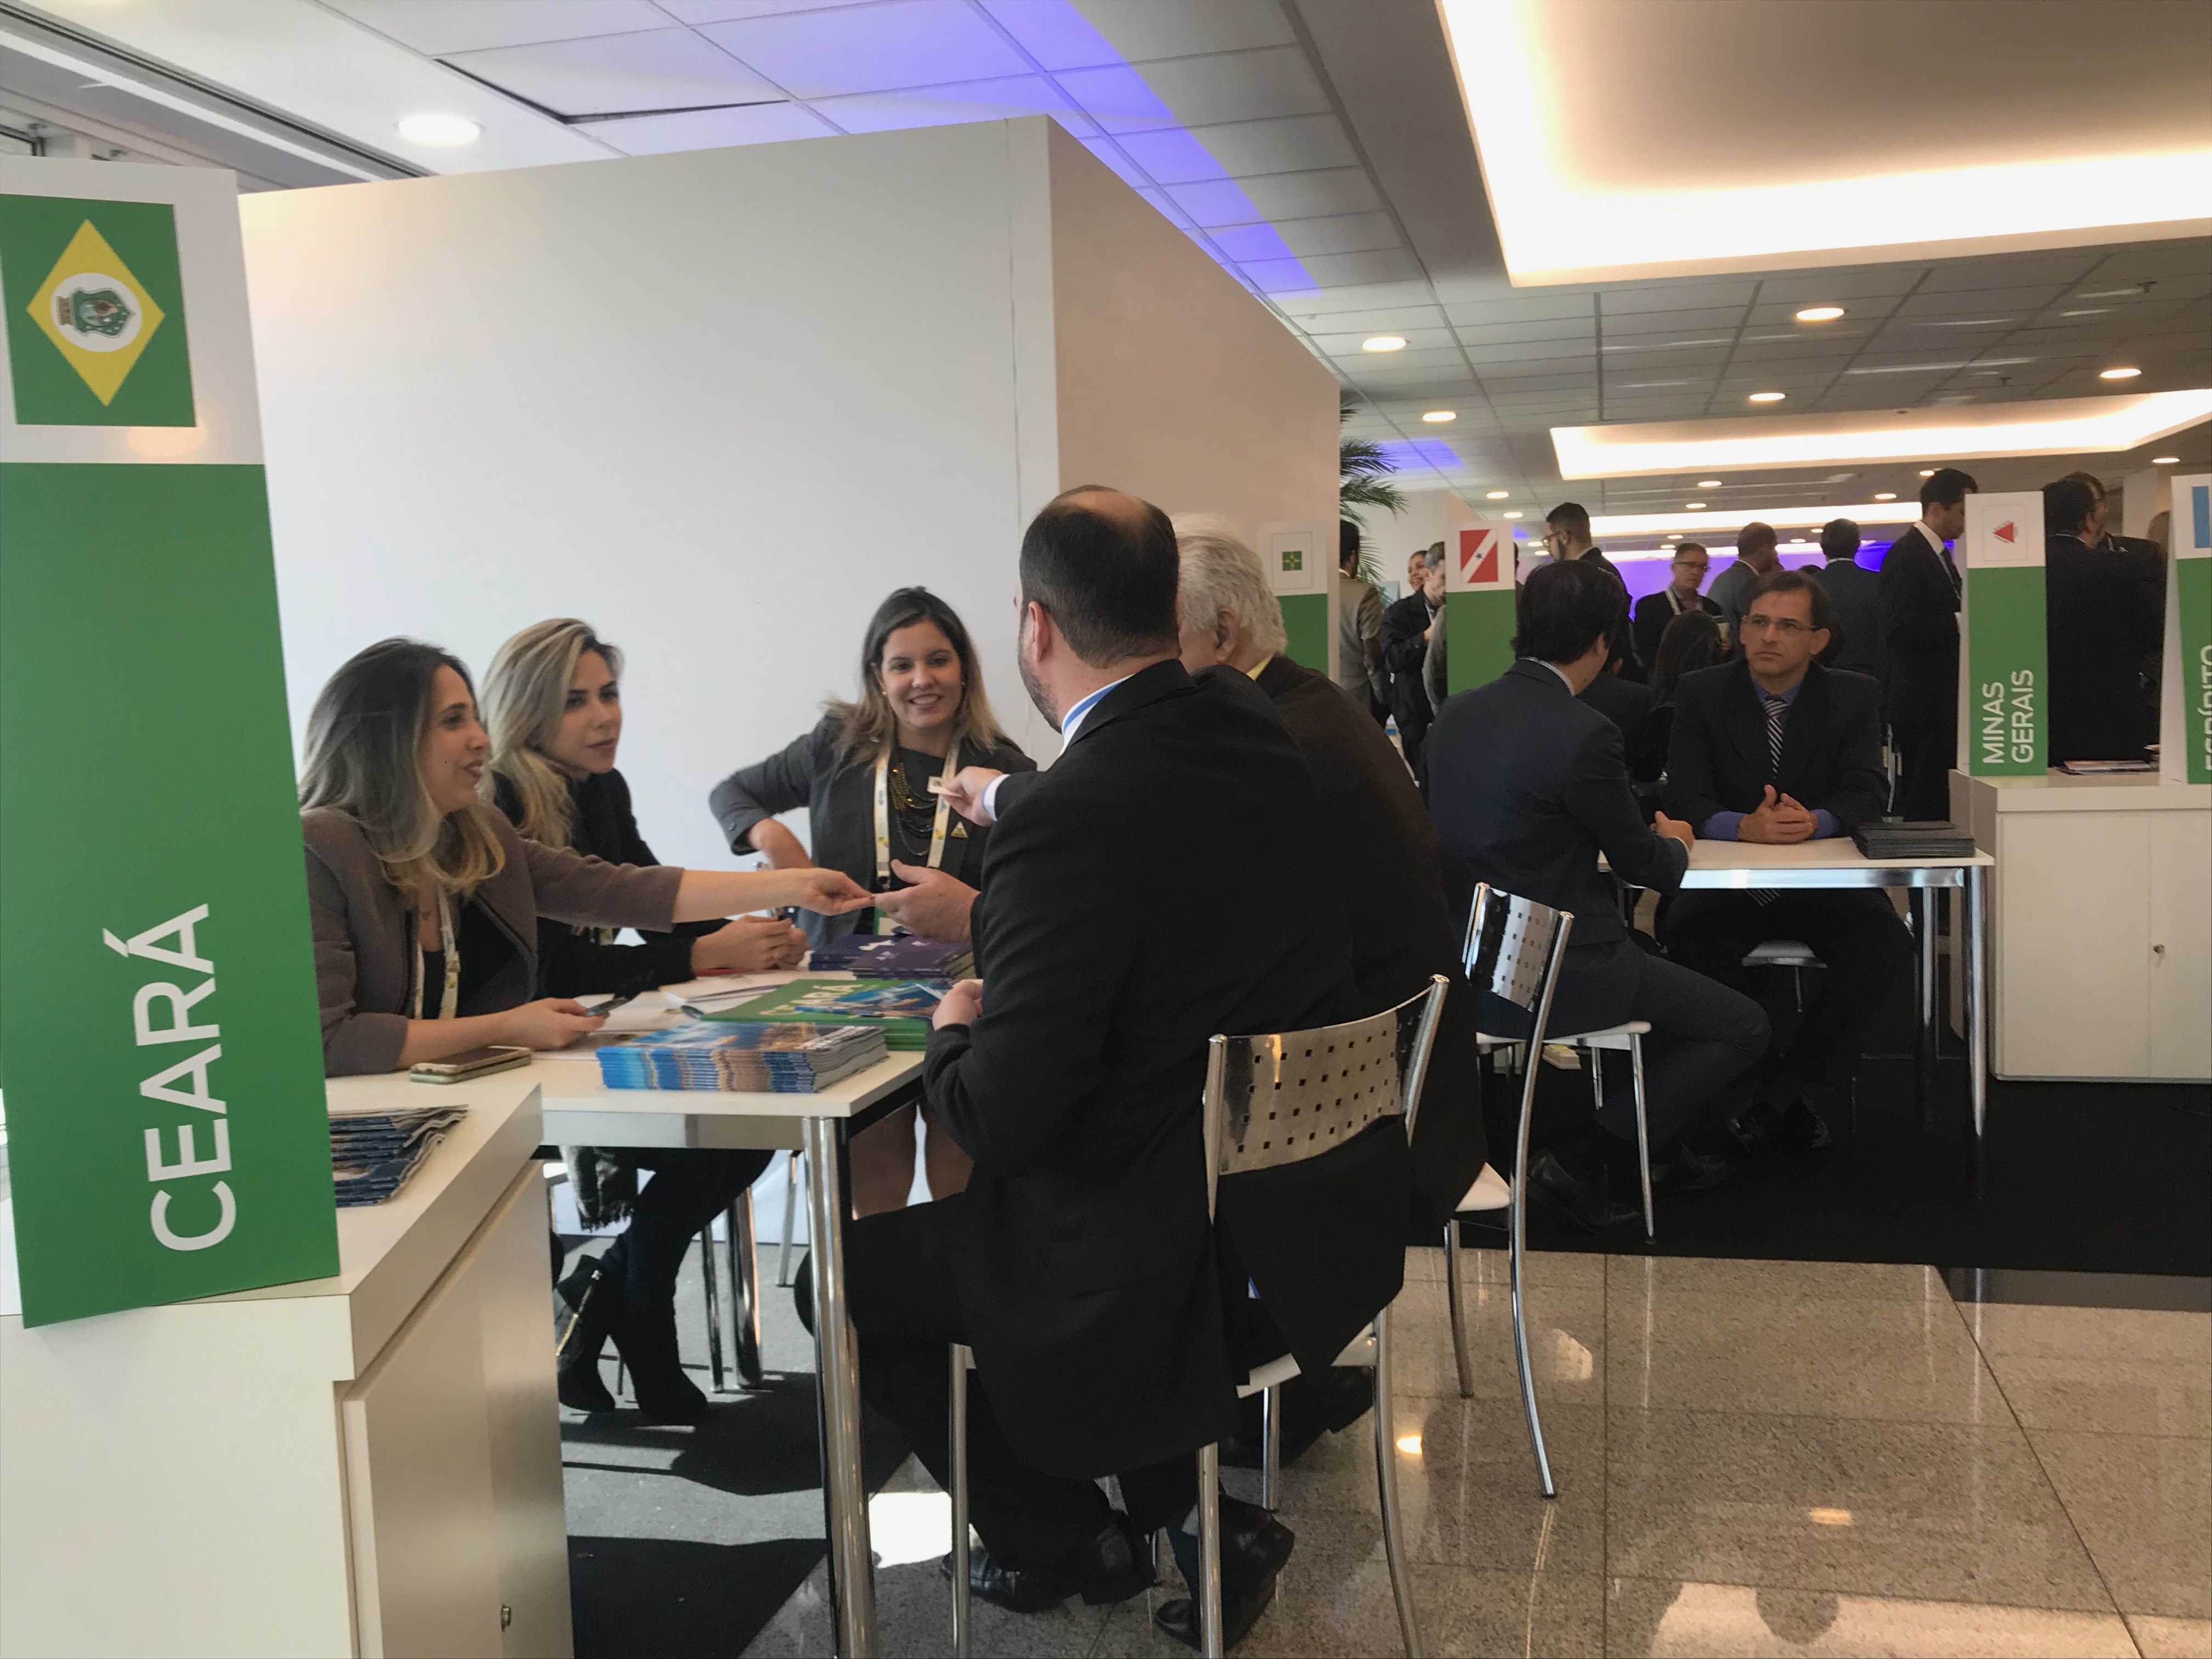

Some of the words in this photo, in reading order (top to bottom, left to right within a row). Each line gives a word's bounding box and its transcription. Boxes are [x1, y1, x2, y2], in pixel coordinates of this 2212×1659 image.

[1982, 682, 2005, 763] MINAS
[2011, 670, 2034, 763] GERAIS
[102, 903, 236, 1251] CEARÁ
